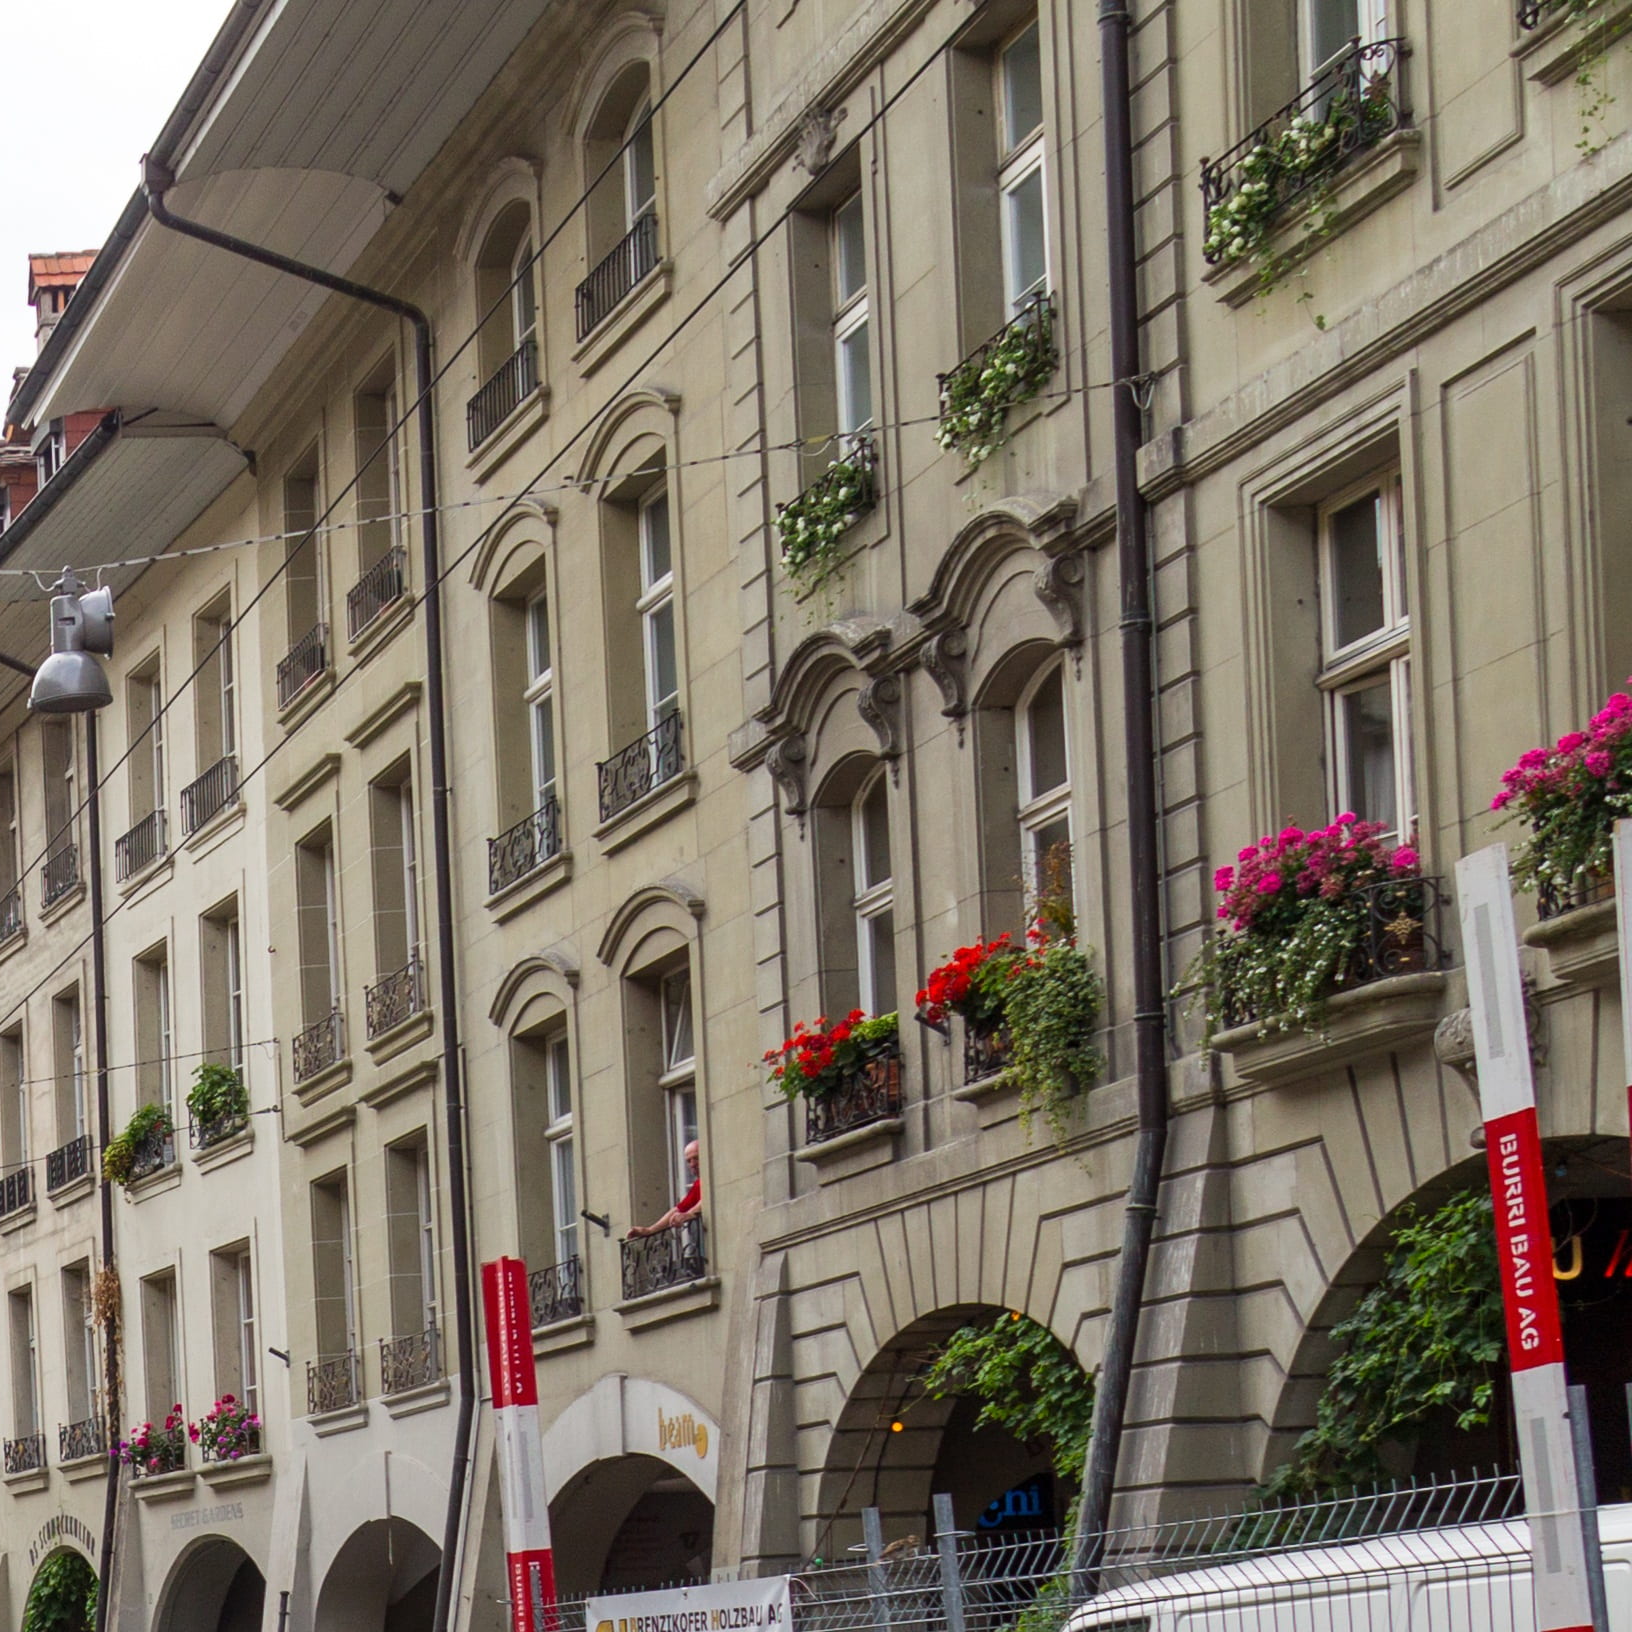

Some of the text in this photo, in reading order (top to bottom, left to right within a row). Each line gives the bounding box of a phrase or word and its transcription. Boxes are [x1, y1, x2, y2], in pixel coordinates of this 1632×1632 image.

[1499, 1133, 1540, 1351] BURRI BAU AG
[515, 1563, 525, 1617] BURRI
[711, 1606, 762, 1631] HOLZBAU
[768, 1603, 783, 1625] AG
